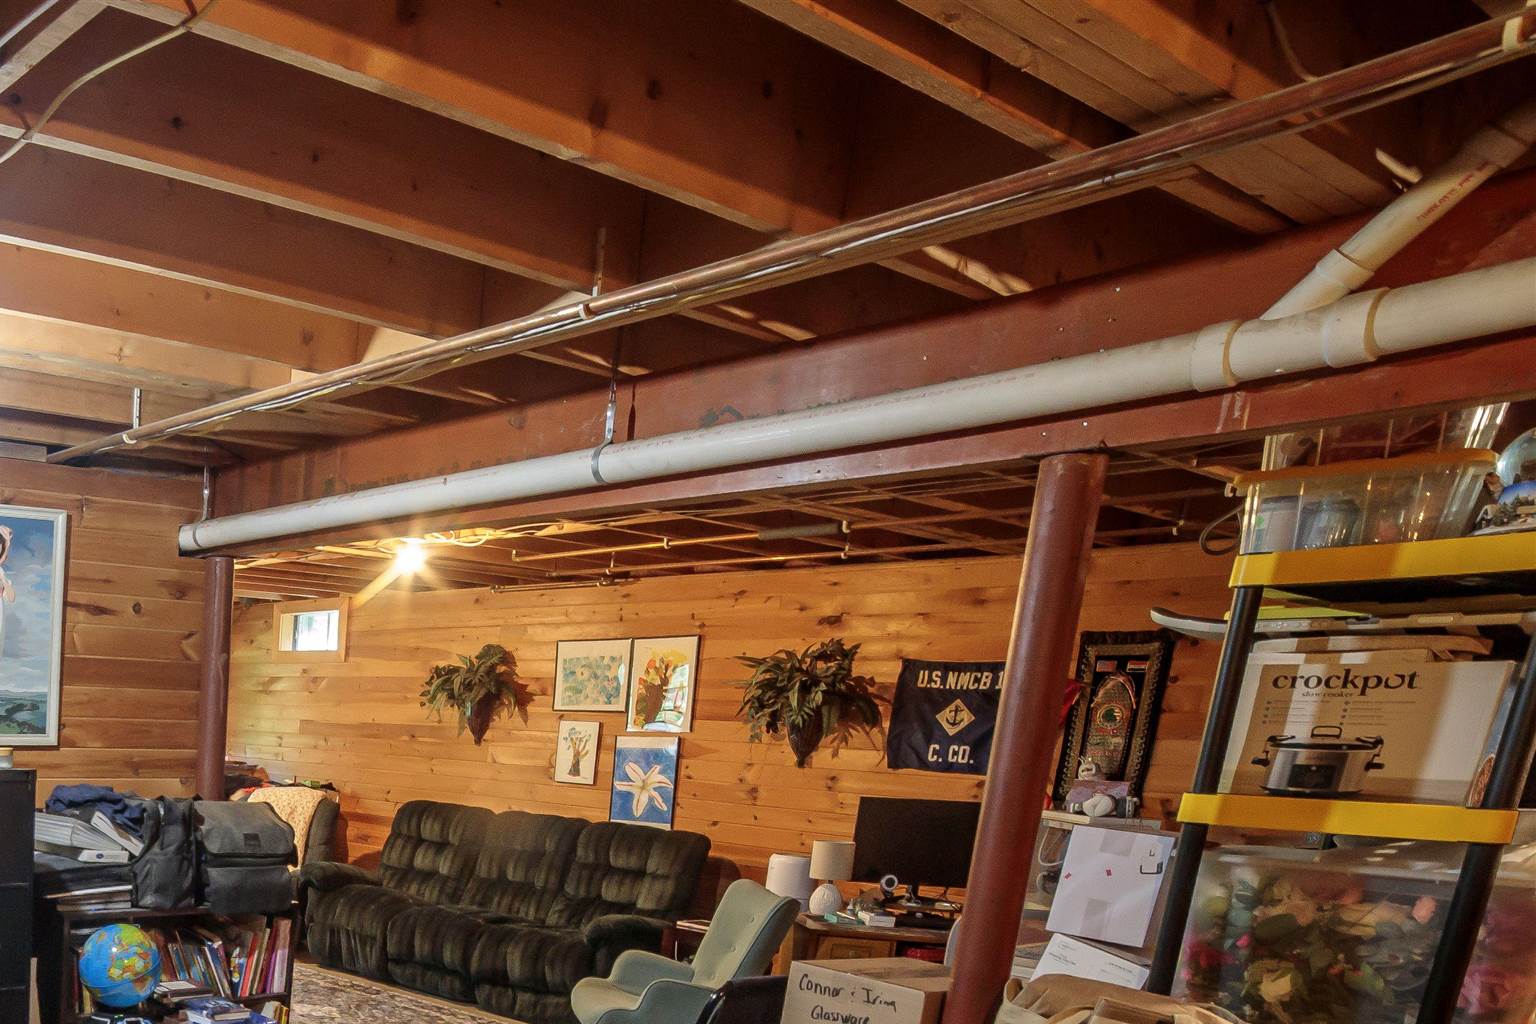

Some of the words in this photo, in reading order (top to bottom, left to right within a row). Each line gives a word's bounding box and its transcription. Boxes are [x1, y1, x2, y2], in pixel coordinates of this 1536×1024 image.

[917, 670, 943, 689] U.S.
[946, 671, 993, 690] NMCB
[1272, 668, 1419, 697] crockpot
[928, 744, 943, 762] C.
[947, 745, 974, 764] CO.
[799, 974, 843, 997] Connor
